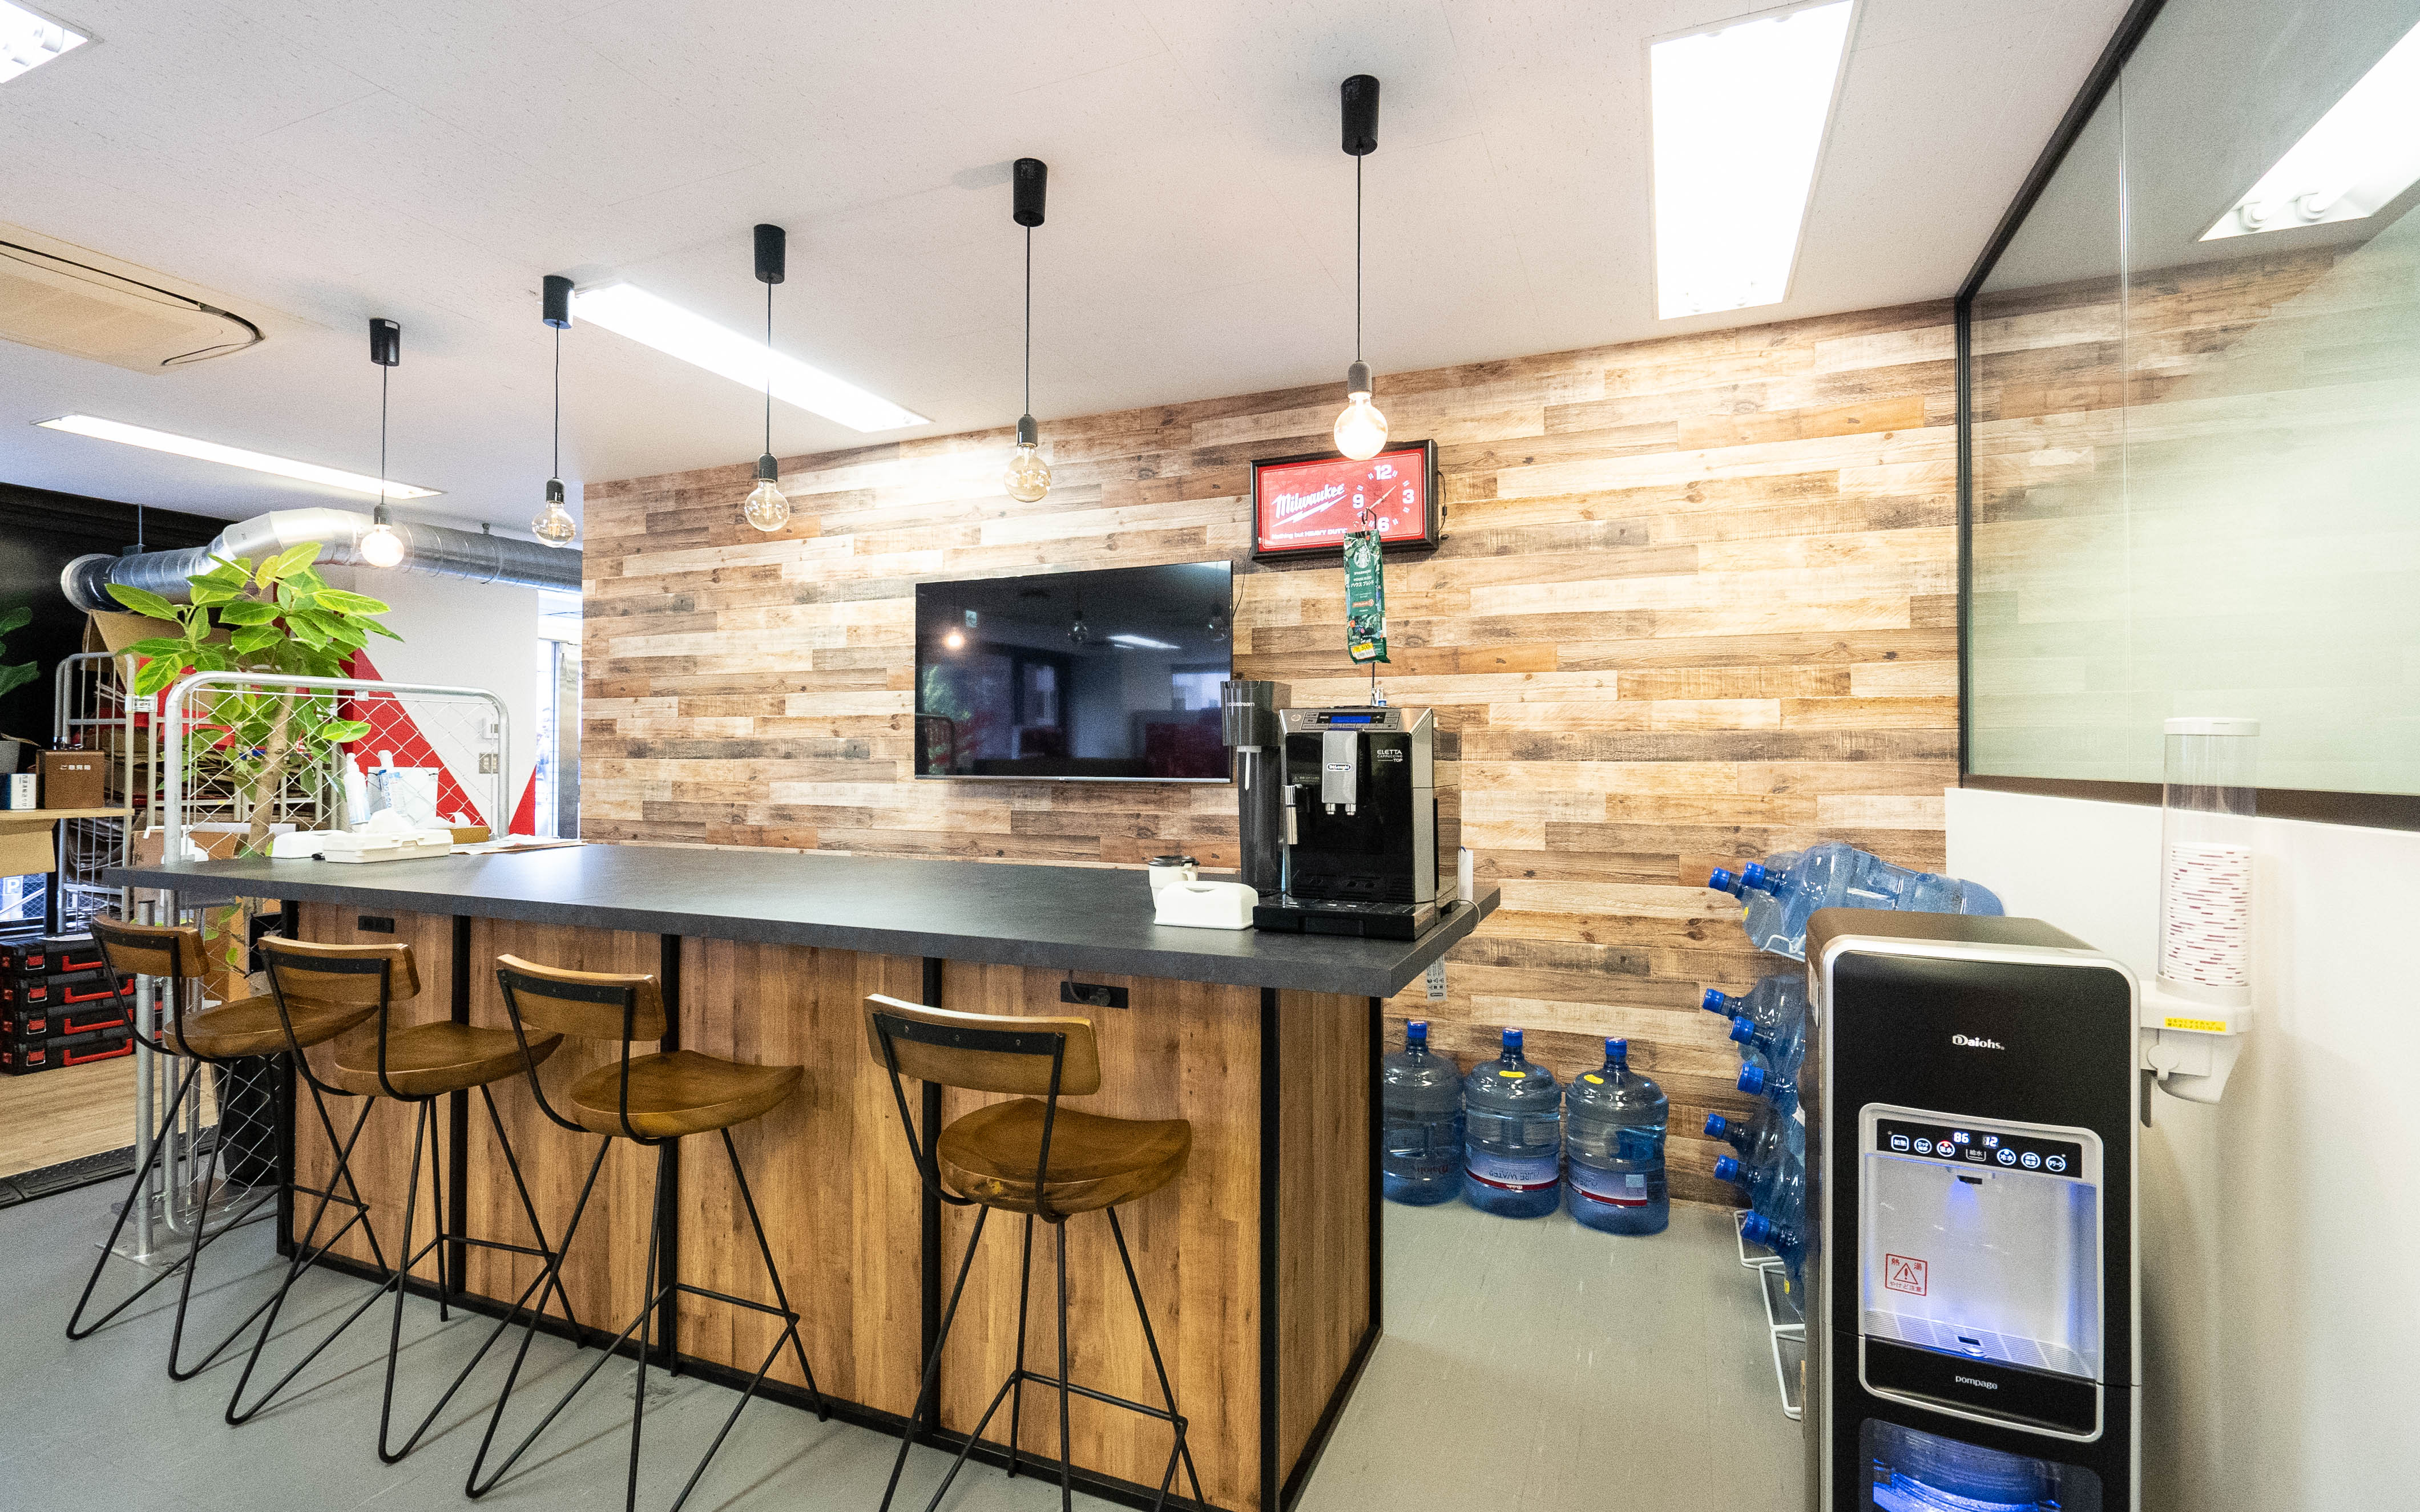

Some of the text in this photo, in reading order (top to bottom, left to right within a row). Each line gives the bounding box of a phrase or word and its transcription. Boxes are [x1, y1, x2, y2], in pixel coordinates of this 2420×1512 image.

[1374, 464, 1392, 480] 12
[1271, 483, 1345, 519] Milwaukee
[1353, 494, 1364, 509] 9
[1402, 489, 1414, 504] 3
[1378, 517, 1390, 532] 6
[7, 879, 19, 893] P
[1954, 1132, 1969, 1143] 86
[1890, 1281, 1922, 1292] やけど注意
[1955, 1376, 1998, 1390] pompage
